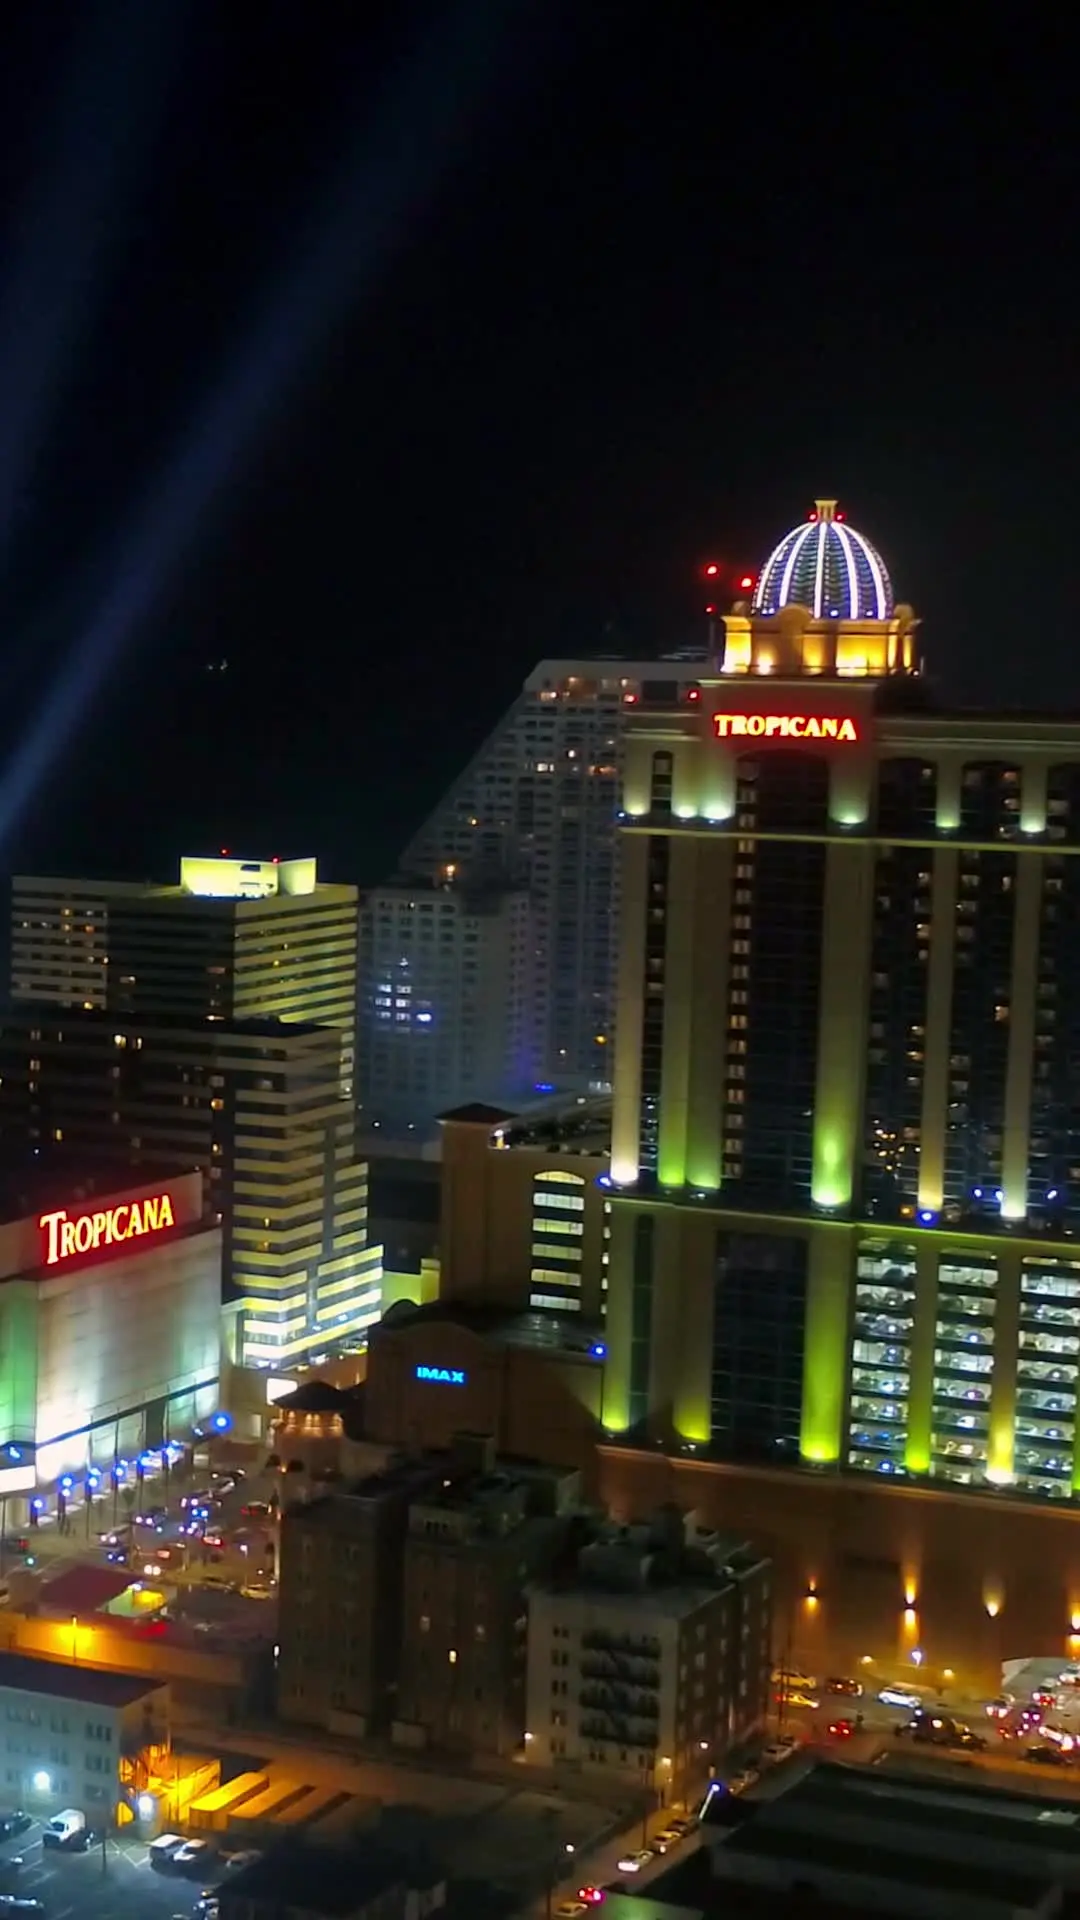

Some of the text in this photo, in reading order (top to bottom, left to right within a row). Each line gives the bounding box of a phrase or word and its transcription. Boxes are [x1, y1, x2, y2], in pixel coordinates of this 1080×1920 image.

[714, 714, 857, 741] TROPICANA
[40, 1194, 174, 1264] TROPICANA
[416, 1366, 465, 1384] IMAX
